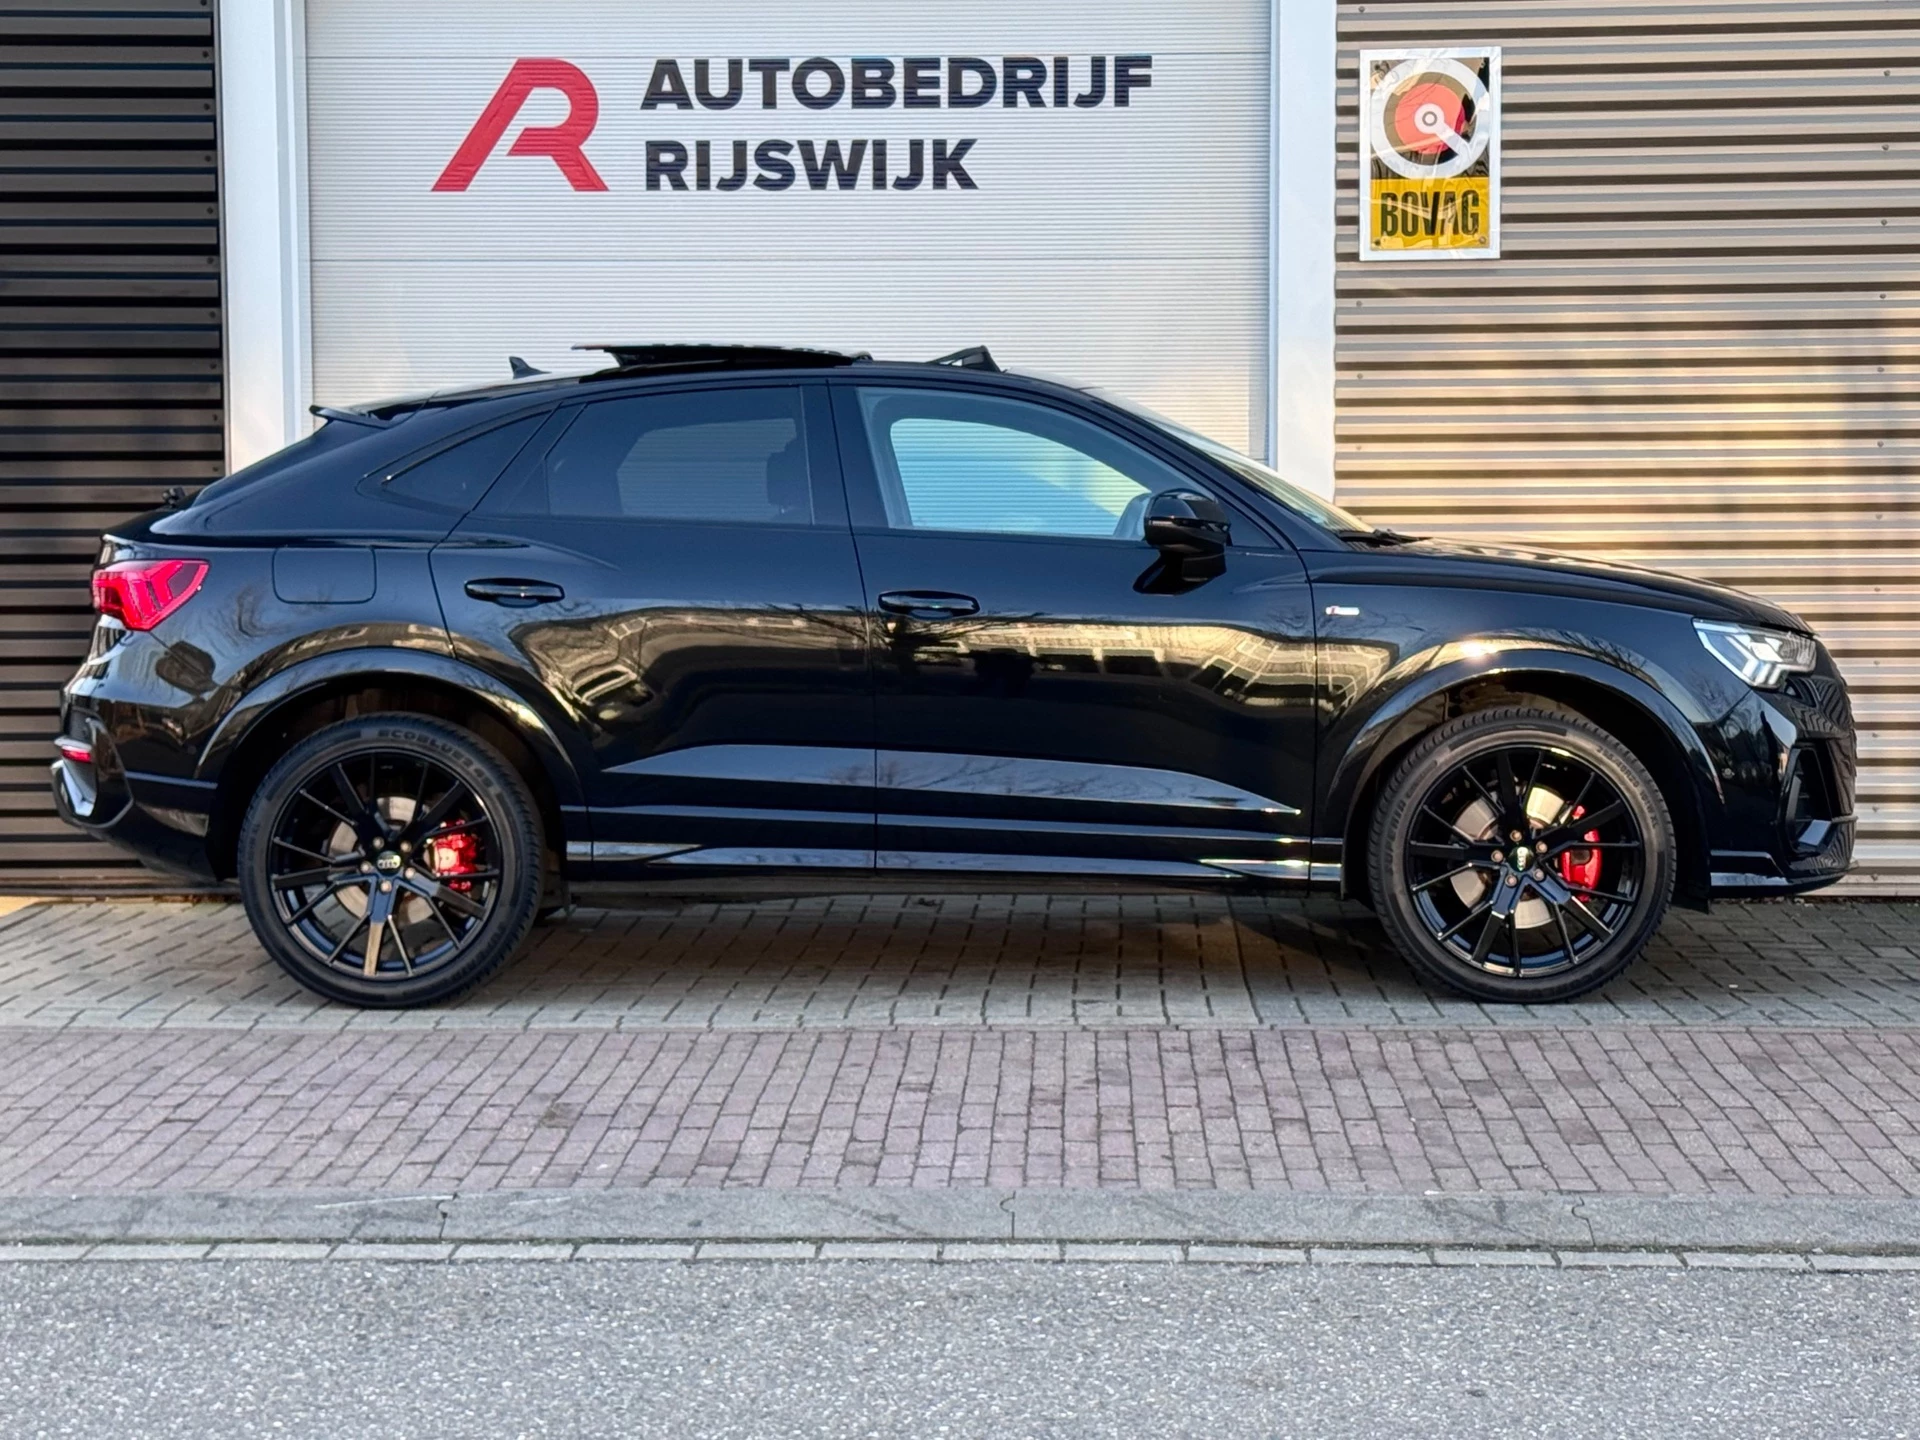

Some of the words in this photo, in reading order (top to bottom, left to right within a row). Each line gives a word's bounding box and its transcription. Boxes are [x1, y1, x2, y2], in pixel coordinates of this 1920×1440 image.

[640, 55, 1152, 111] AUTOBEDRIJF
[645, 137, 979, 191] RIJSWIJK
[1380, 189, 1479, 237] BOVAG
